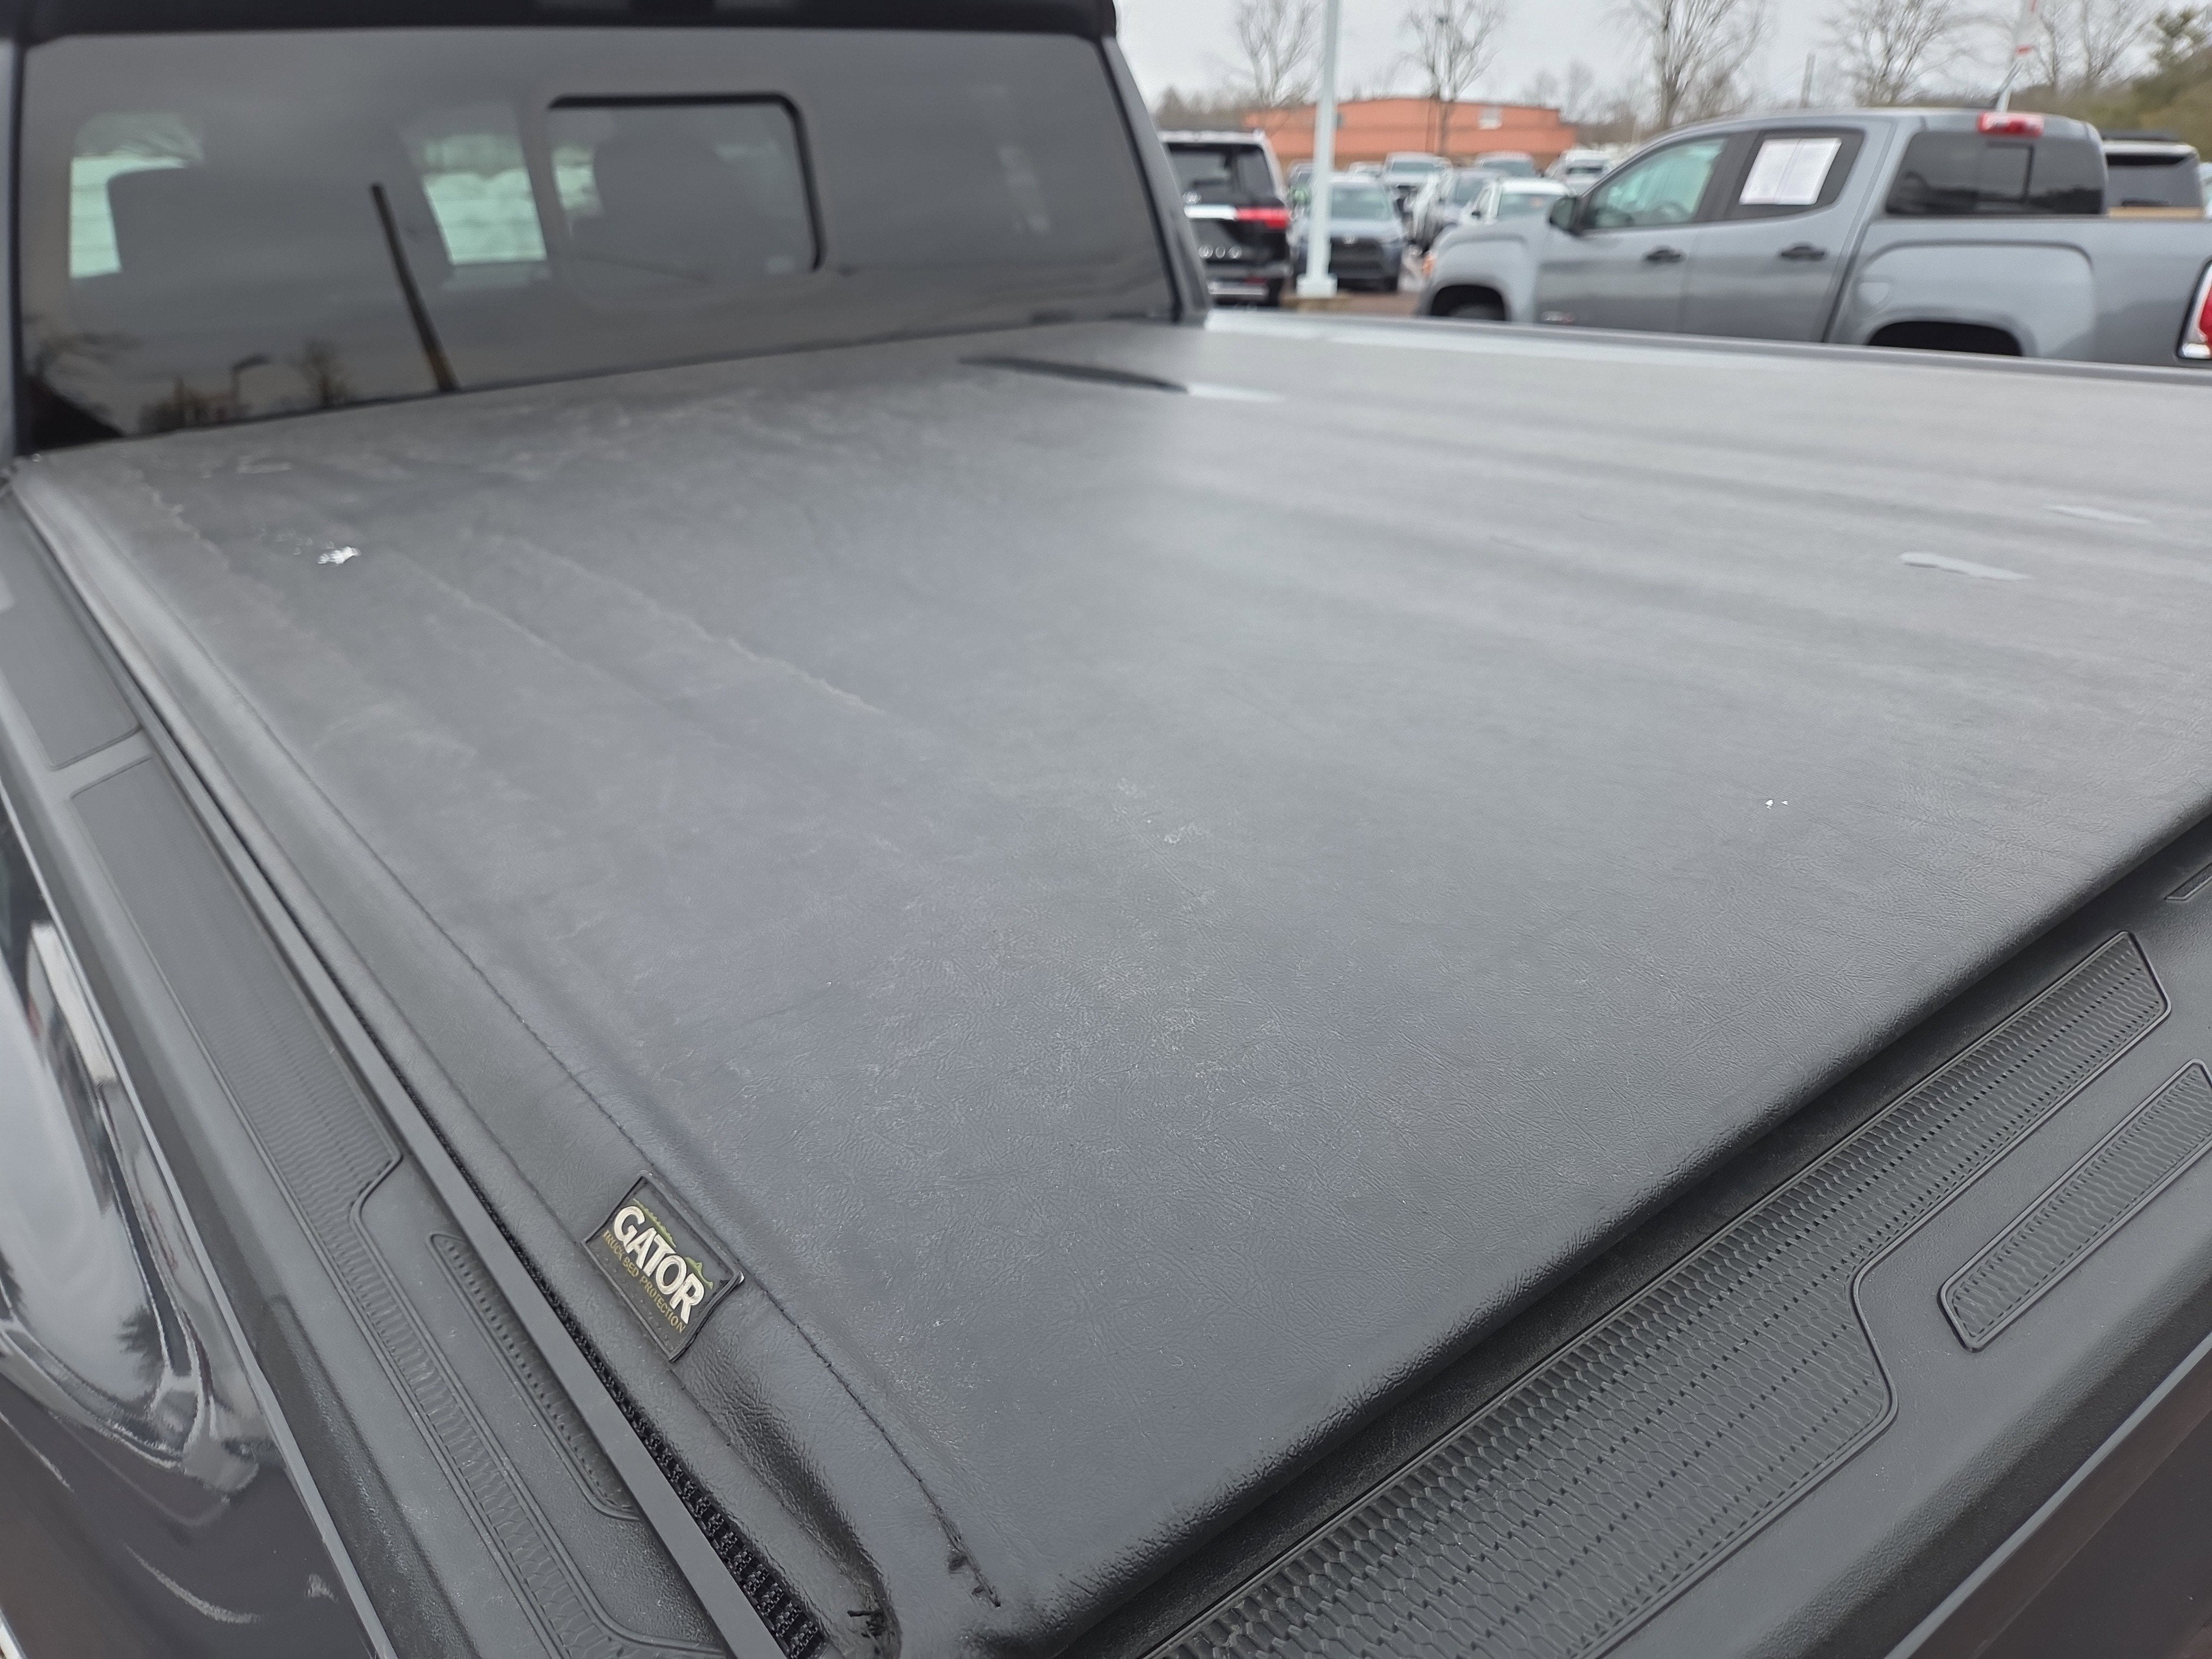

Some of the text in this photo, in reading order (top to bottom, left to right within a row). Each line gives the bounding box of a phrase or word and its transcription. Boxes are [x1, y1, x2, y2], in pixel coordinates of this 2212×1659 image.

[603, 1230, 686, 1334] TRUCK BED PROTECTION
[614, 1206, 704, 1324] GATOR
